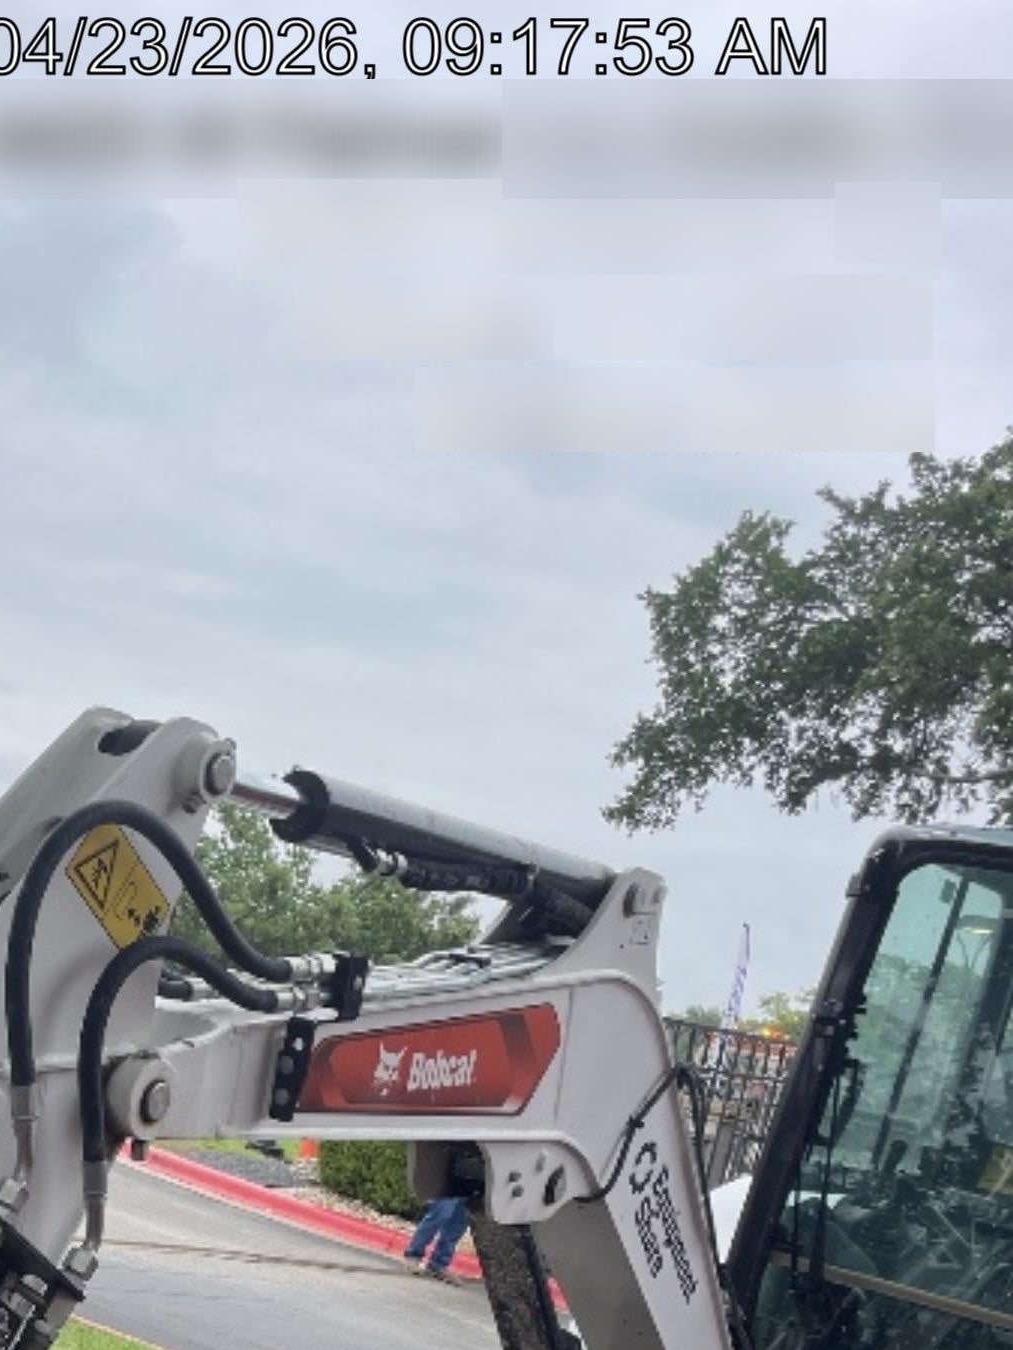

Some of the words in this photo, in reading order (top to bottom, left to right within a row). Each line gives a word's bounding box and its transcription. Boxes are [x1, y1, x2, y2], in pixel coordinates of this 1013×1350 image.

[407, 1048, 477, 1093] Bobcat
[635, 1196, 663, 1278] Share
[653, 1163, 698, 1305] Equipment
